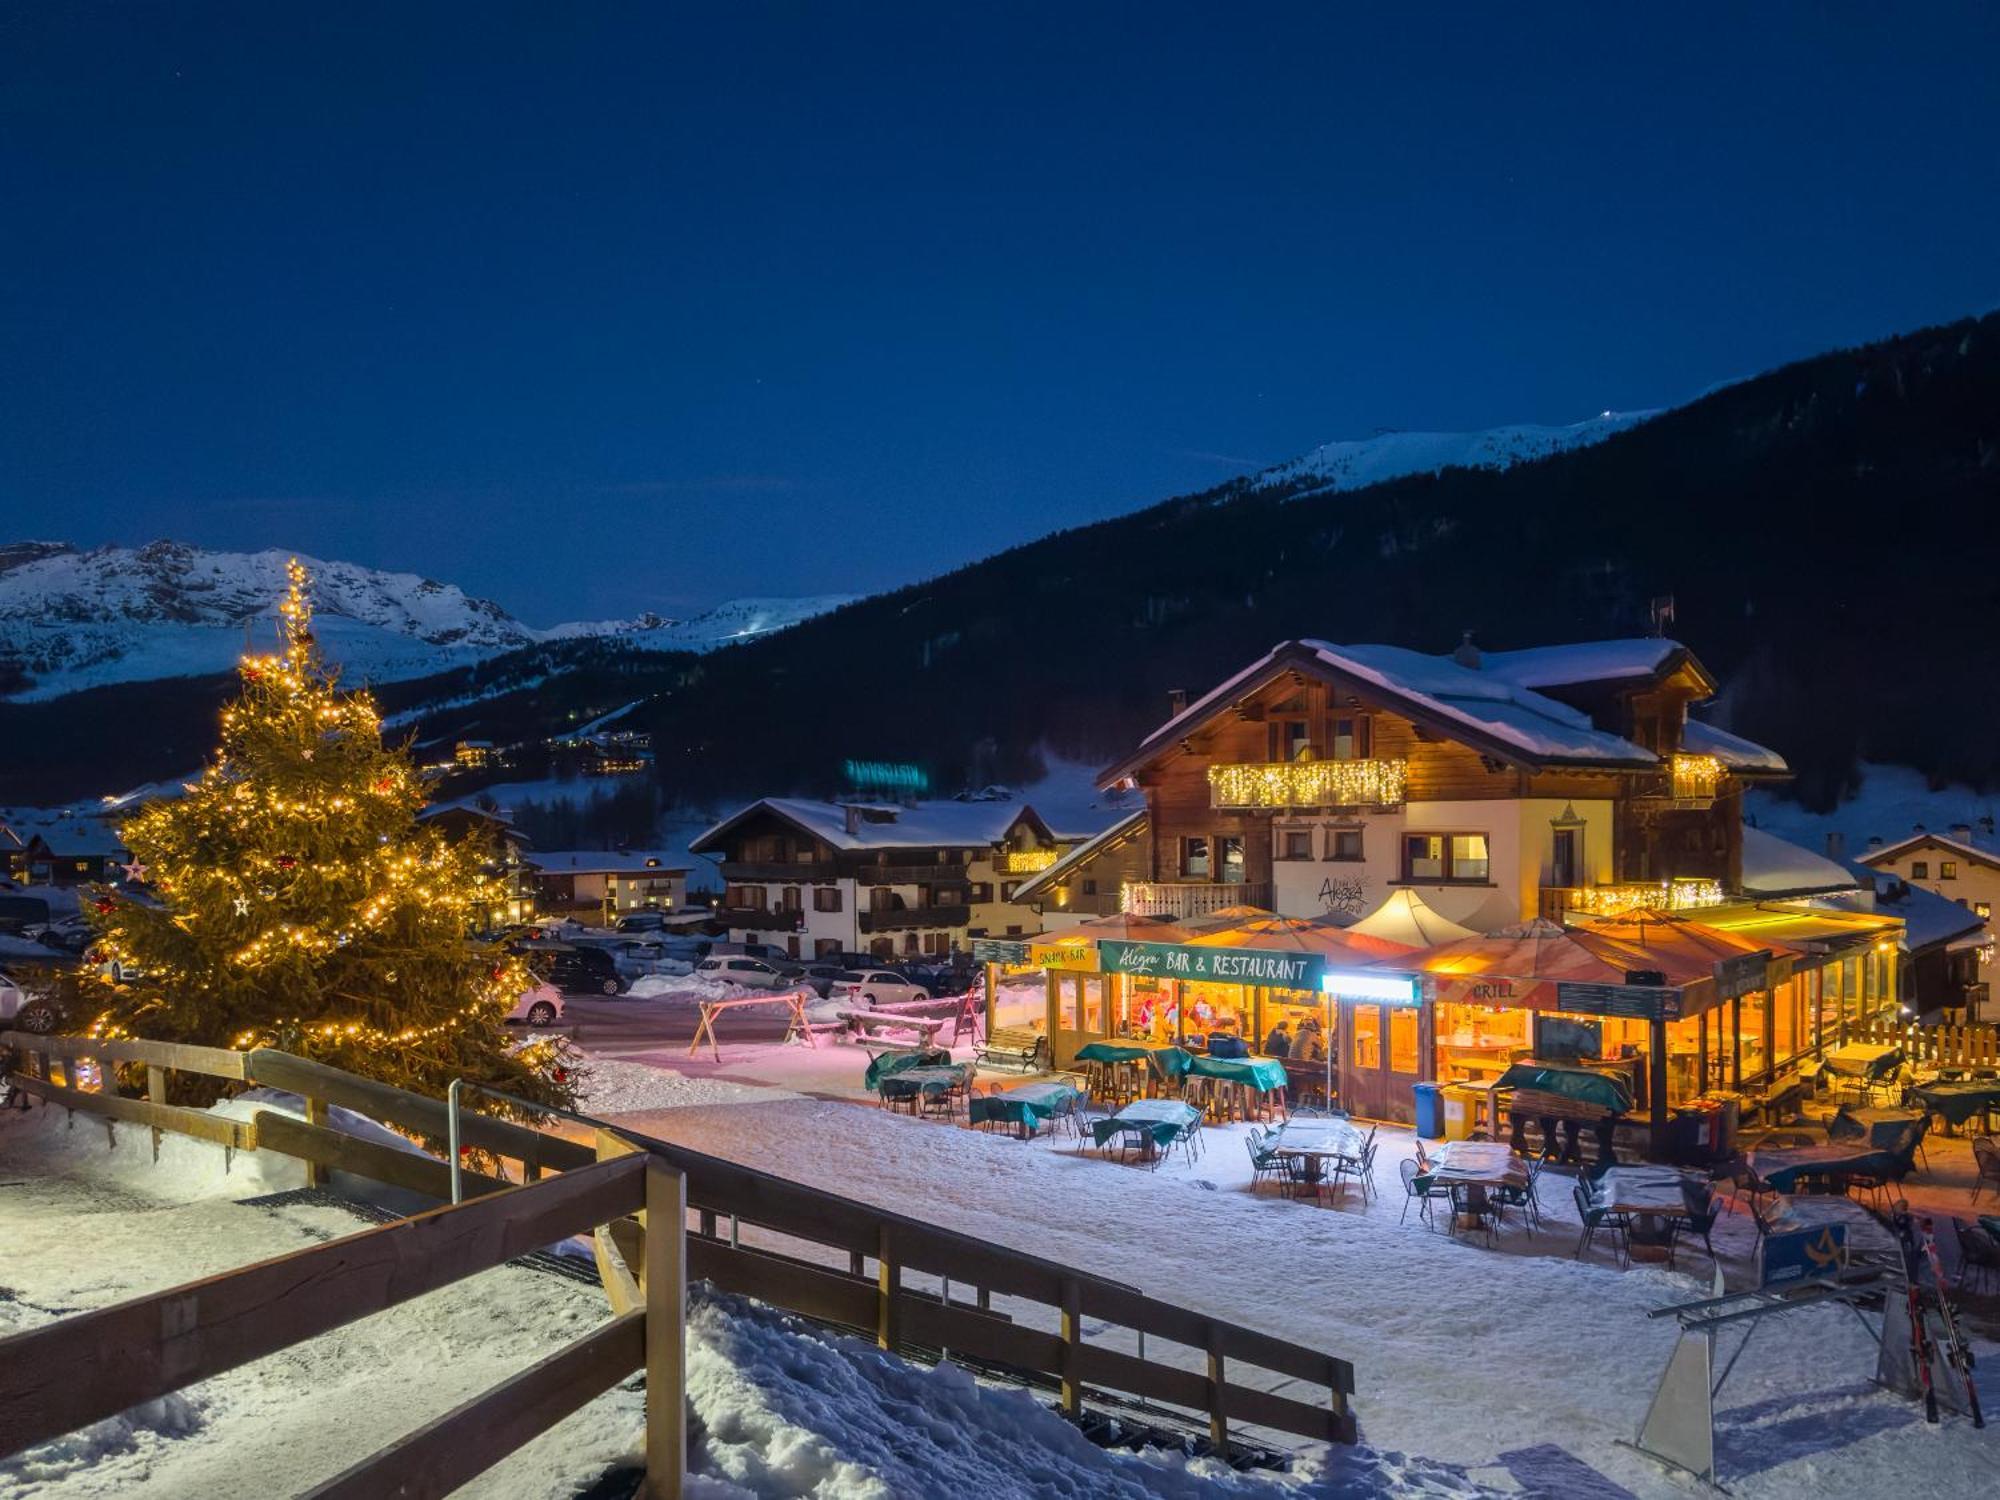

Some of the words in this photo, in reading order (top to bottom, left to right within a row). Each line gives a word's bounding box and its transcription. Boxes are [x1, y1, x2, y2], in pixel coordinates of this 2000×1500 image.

[1119, 946, 1160, 973] Alegra
[1166, 951, 1190, 973] BAR
[1195, 957, 1207, 972] &
[1212, 955, 1307, 980] RESTAURANT
[1472, 983, 1518, 999] GRILL
